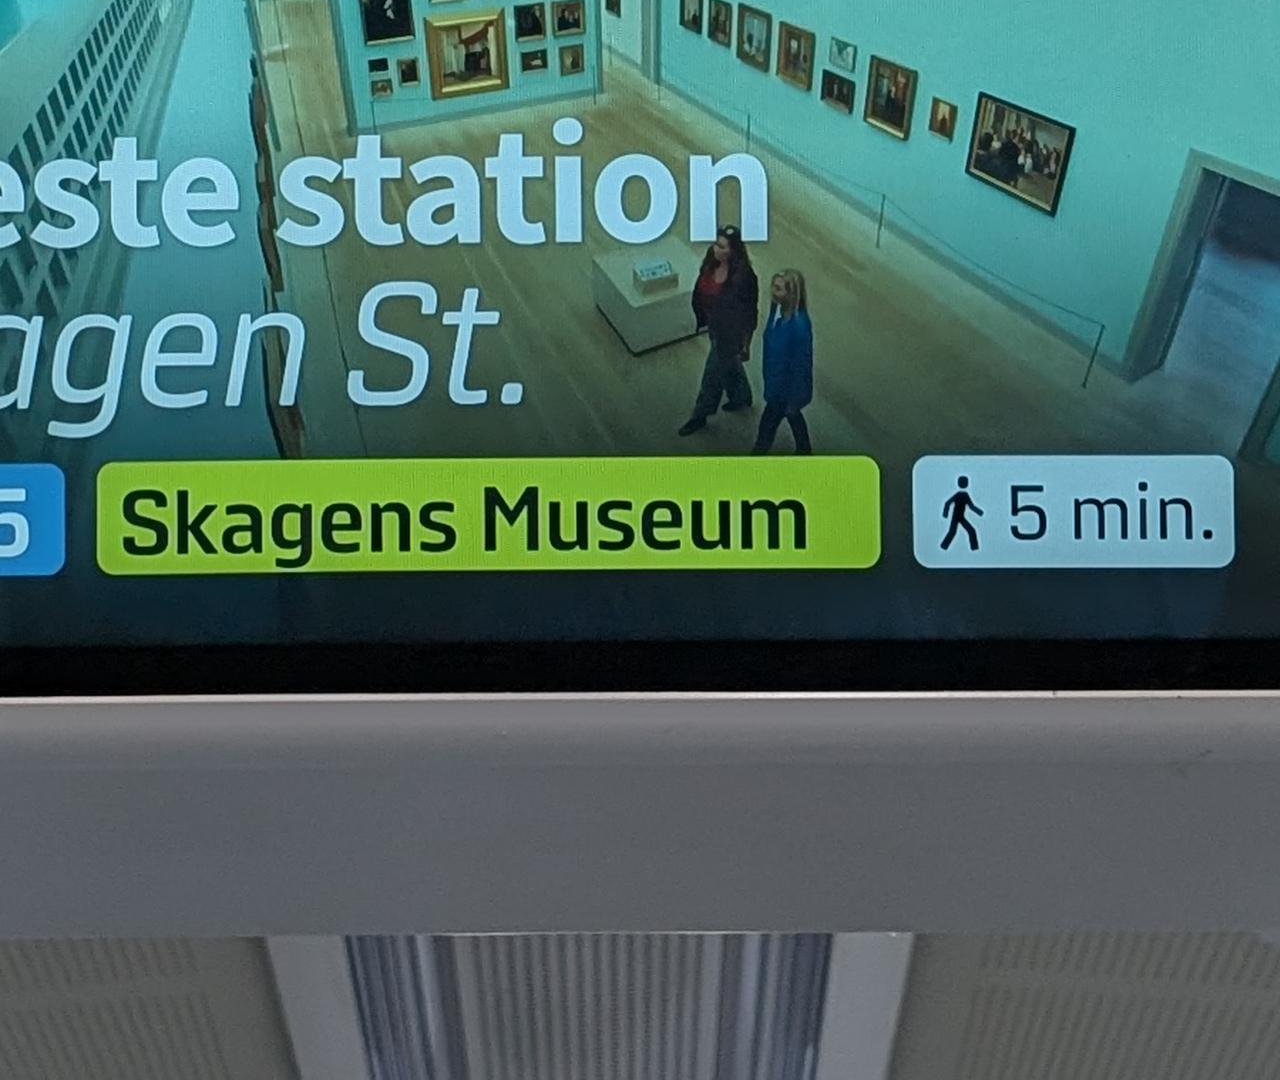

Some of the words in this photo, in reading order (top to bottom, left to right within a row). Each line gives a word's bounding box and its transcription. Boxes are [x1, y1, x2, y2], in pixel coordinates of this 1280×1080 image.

[275, 118, 768, 248] station
[345, 280, 524, 408] St.
[119, 484, 457, 568] Skagens
[482, 484, 810, 554] Museum
[1008, 482, 1048, 542] 5
[1071, 478, 1216, 543] min.
